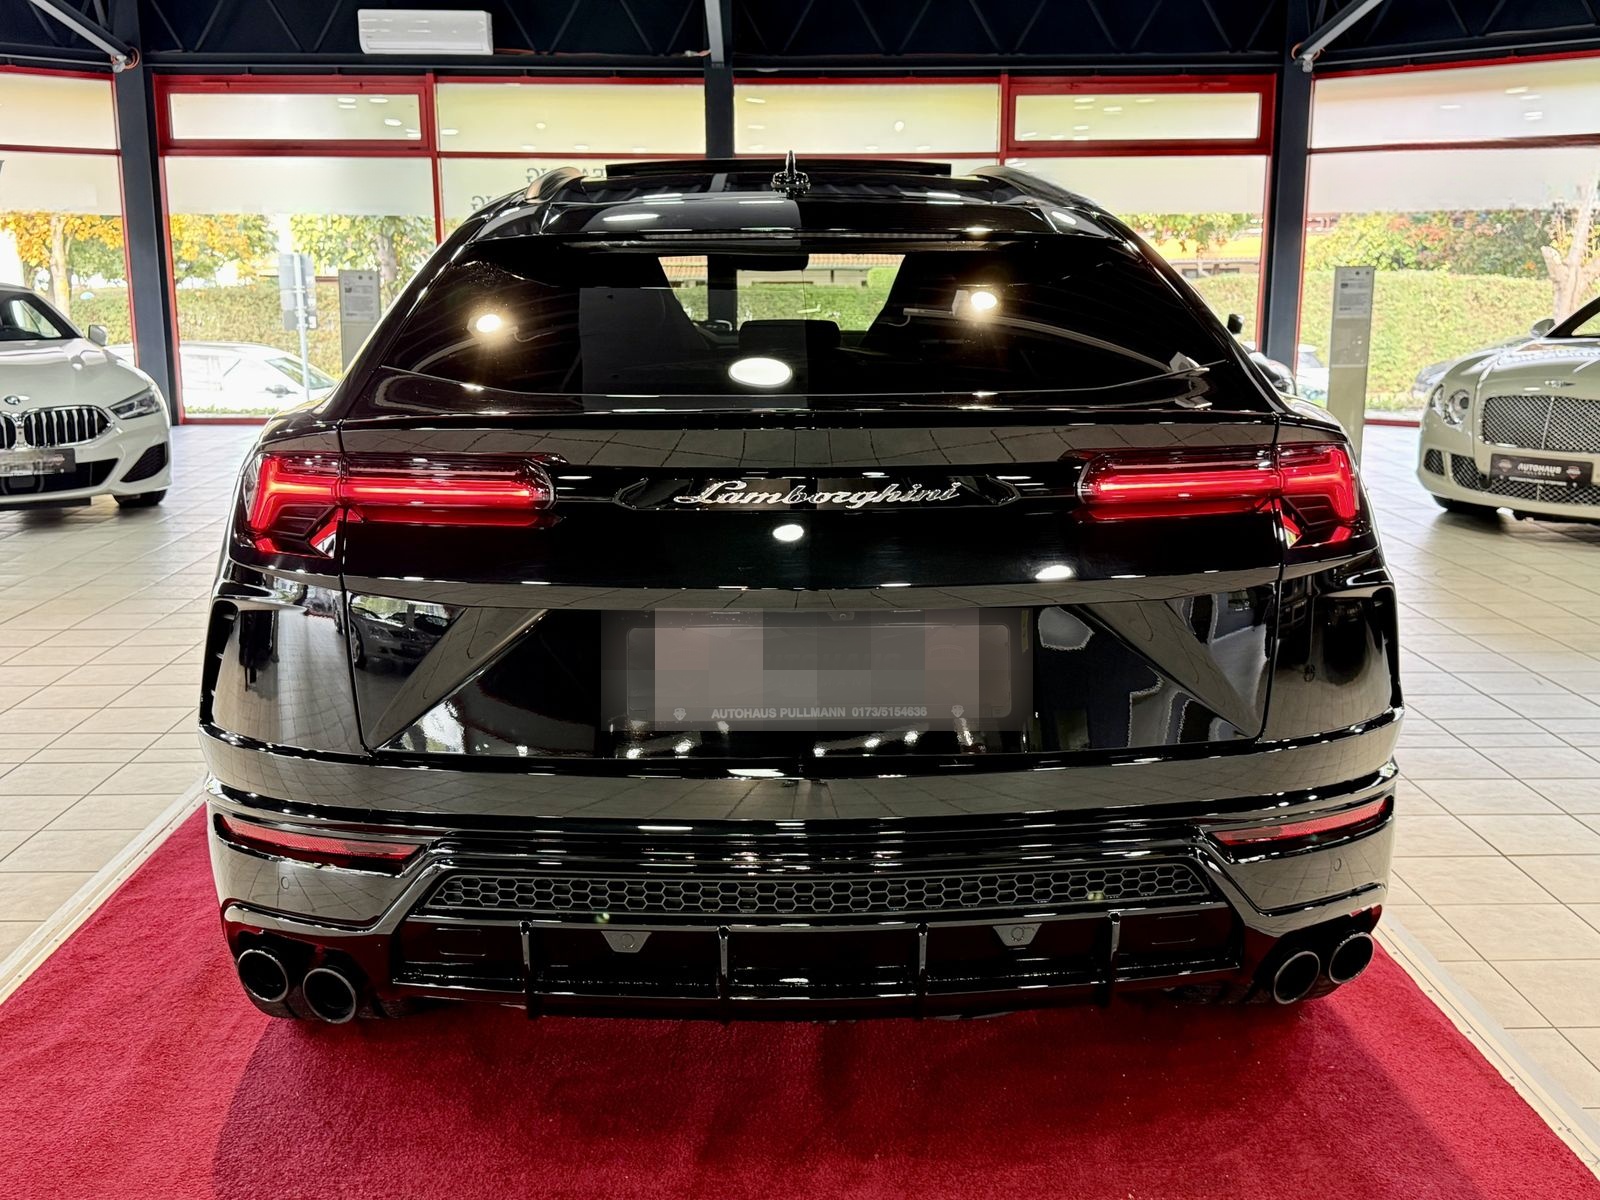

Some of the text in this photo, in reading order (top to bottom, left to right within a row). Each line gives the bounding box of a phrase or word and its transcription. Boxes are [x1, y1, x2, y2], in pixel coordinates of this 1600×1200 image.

[1517, 462, 1562, 474] AUTOHAUS
[673, 480, 962, 509] Lamborghini
[711, 705, 928, 720] AUTOHAUS PULLMANN 0173/5154636
